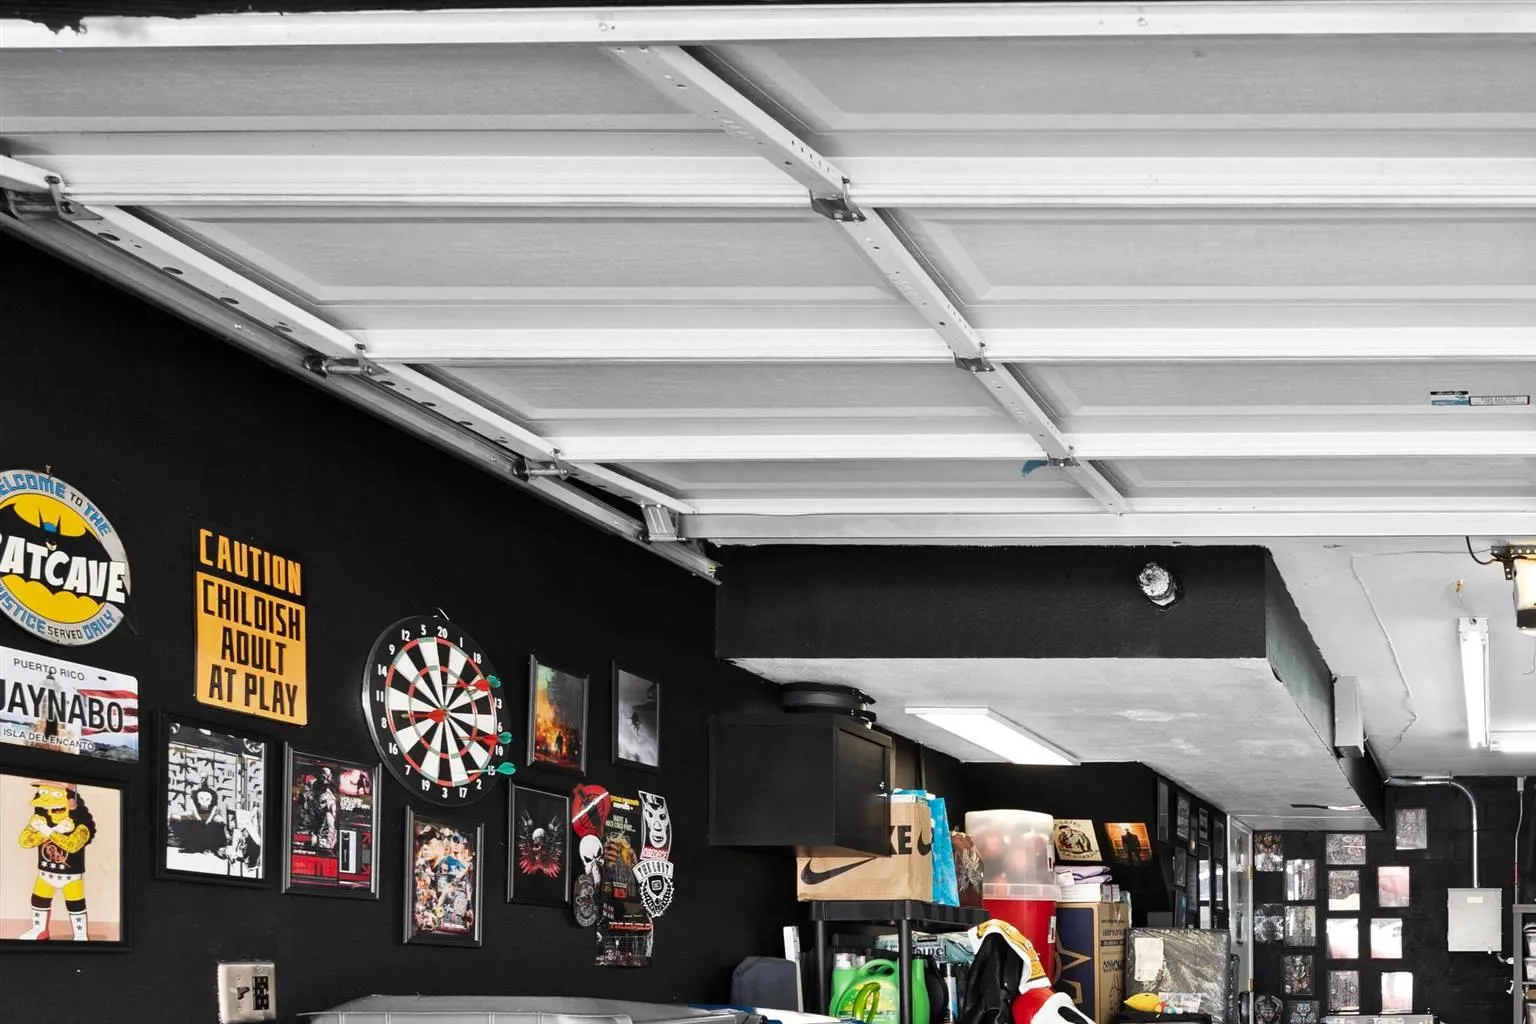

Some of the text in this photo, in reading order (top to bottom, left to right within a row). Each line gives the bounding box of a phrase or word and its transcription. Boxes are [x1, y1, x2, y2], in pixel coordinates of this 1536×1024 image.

[0, 473, 111, 536] ELCOME TO THE
[200, 528, 302, 596] CAUTION
[0, 535, 126, 603] ATCAVE
[0, 584, 116, 640] USTICE SERVED DAILY
[203, 579, 301, 641] CHILDISH
[401, 629, 410, 641] 12
[421, 624, 426, 635] 5
[437, 626, 448, 639] 20
[459, 637, 464, 648] 1
[221, 626, 287, 675] ADULT
[389, 644, 395, 655] 9
[473, 652, 482, 665] 18
[13, 658, 85, 680] PUERTO RICO
[377, 664, 387, 677] 14
[209, 663, 298, 717] AT PLAY
[376, 690, 384, 703] 11
[381, 718, 387, 729] 8
[497, 721, 503, 732] 6
[3, 728, 96, 751] ISLA DEL ENCANTO
[389, 742, 398, 755] 16
[495, 745, 503, 756] 10
[405, 764, 411, 776] 7
[421, 779, 430, 791] 19
[476, 778, 482, 790] 2
[442, 787, 448, 799] 3
[459, 787, 467, 798] 17
